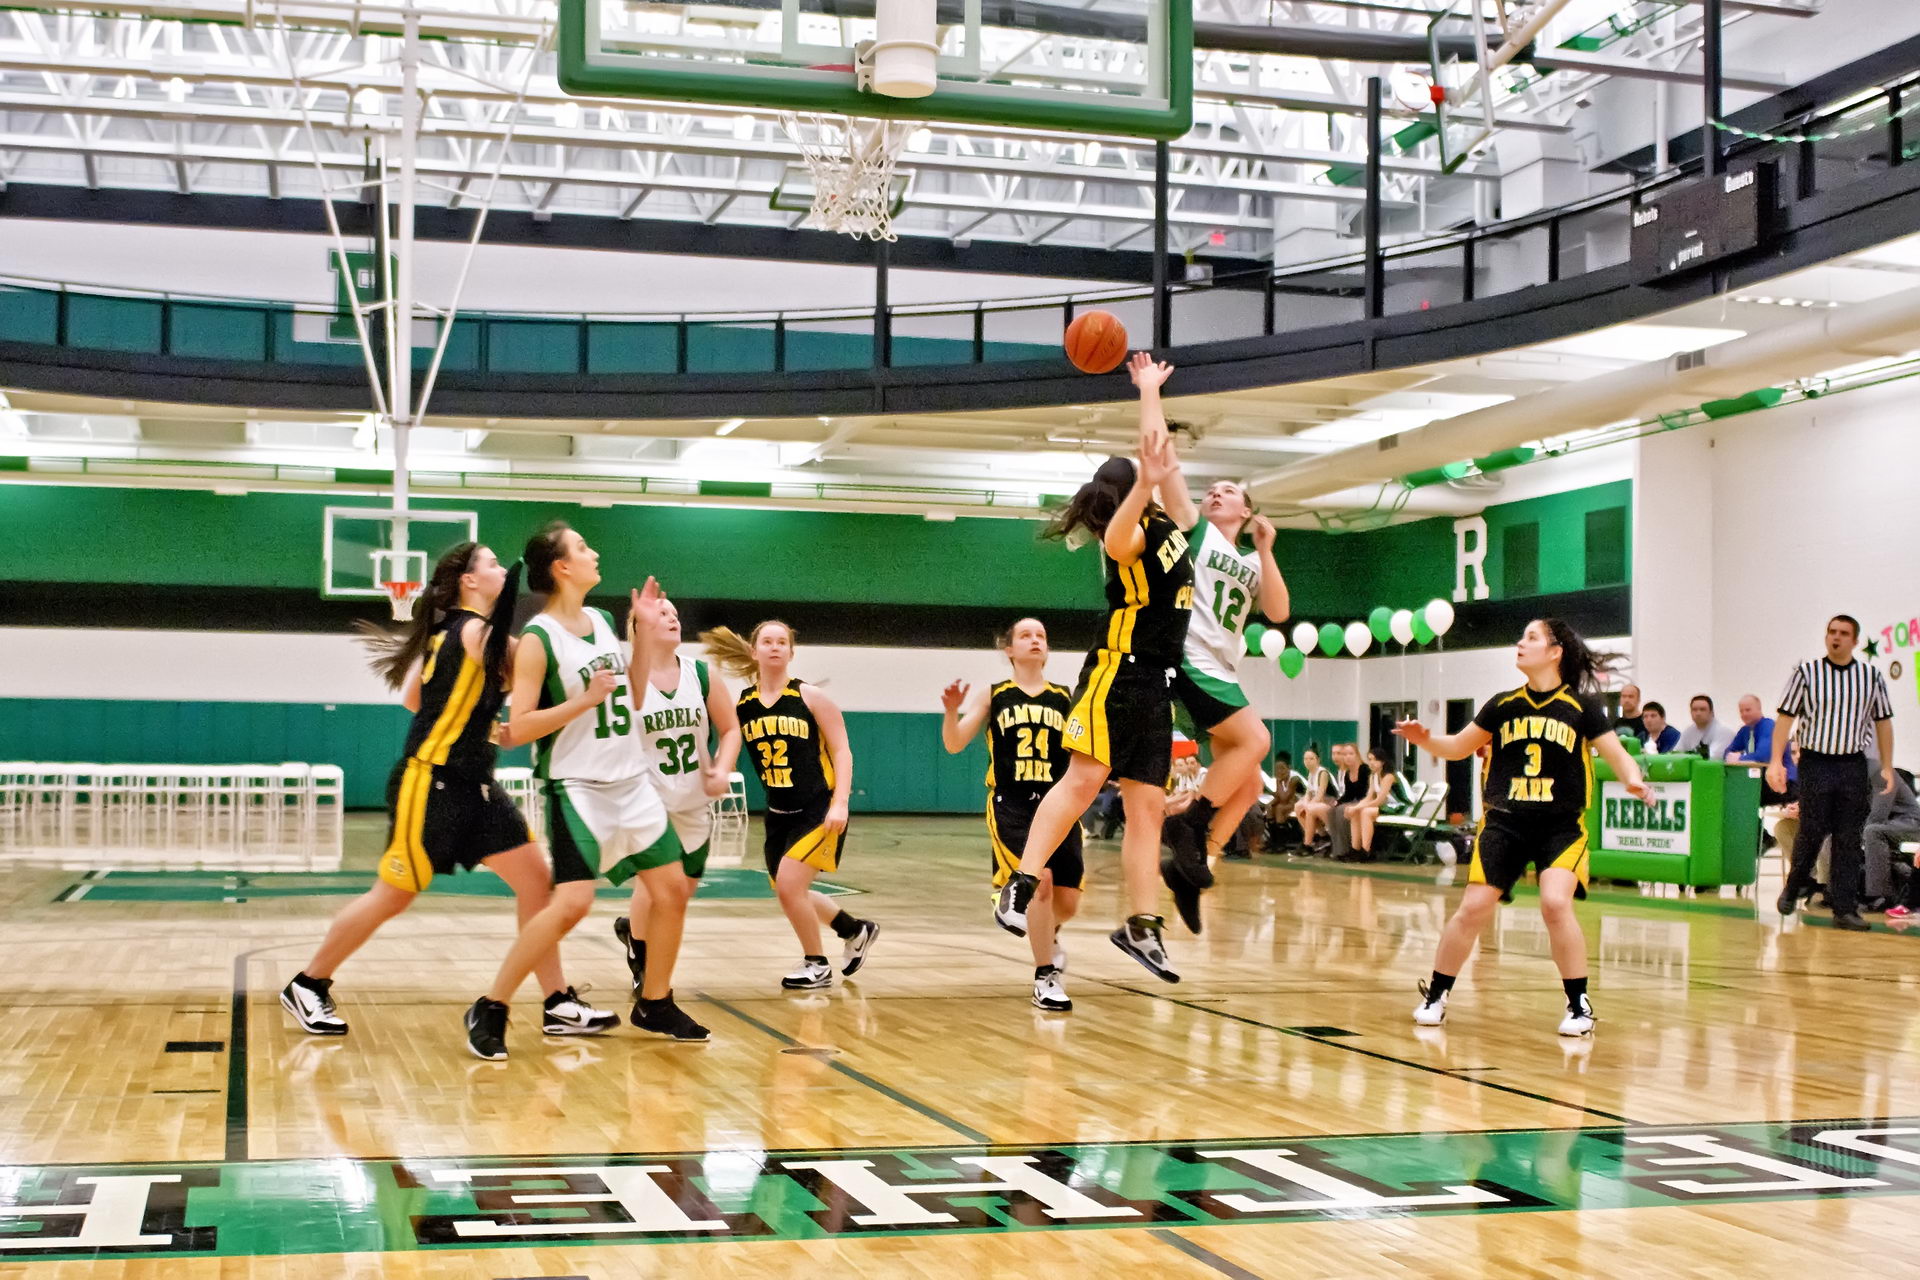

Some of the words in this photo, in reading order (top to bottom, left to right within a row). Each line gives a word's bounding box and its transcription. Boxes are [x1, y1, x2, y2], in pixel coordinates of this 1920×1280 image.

[1452, 516, 1490, 603] R
[1212, 580, 1246, 634] 12
[594, 684, 632, 740] 15
[643, 707, 702, 735] REBELS
[741, 715, 809, 743] LMWOOD
[655, 733, 700, 776] 32
[756, 739, 789, 768] 32
[1016, 727, 1049, 760] 24
[1523, 743, 1542, 777] 3
[1014, 759, 1053, 782] PARK
[1605, 797, 1687, 833] REBELS
